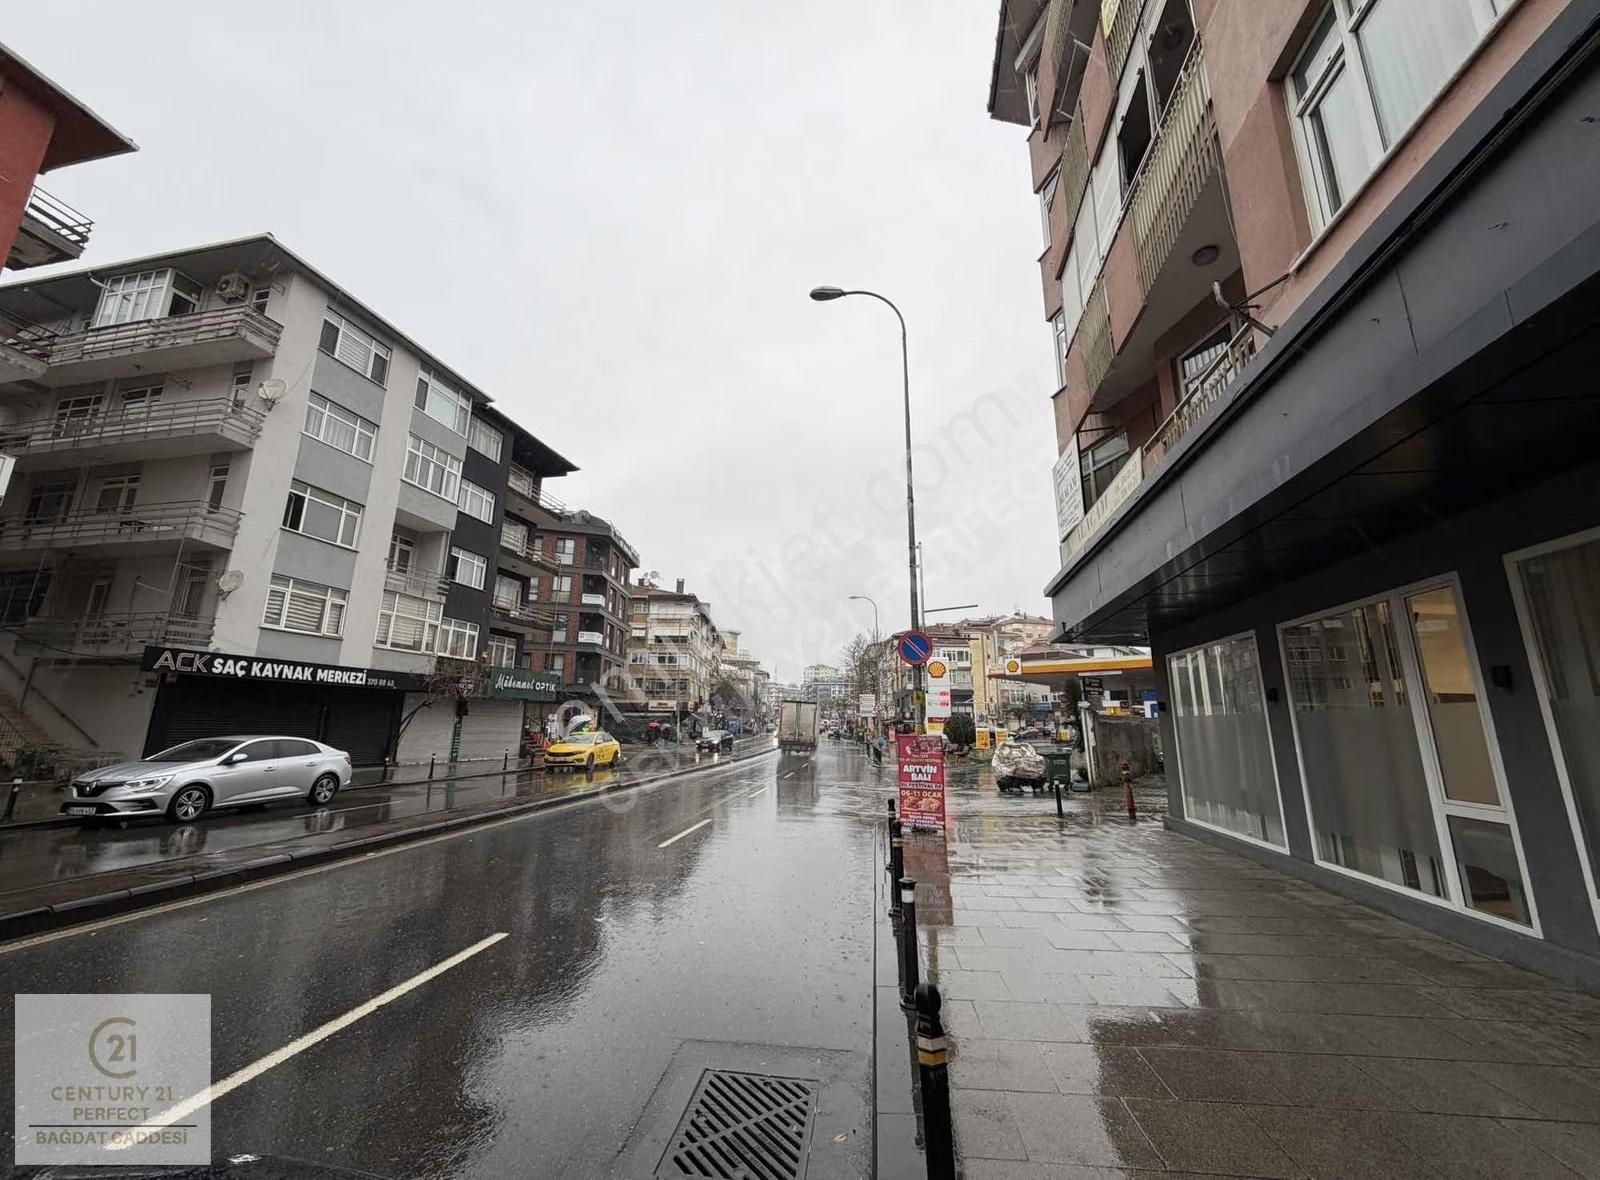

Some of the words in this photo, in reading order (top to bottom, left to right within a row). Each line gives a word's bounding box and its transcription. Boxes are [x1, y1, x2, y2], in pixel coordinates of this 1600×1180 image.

[153, 650, 211, 673] ACK
[211, 658, 248, 677] SAÇ
[251, 662, 314, 681] KAYNAK
[316, 669, 367, 685] MERKEZİ
[903, 763, 938, 774] ARTVİN
[922, 790, 943, 798] OCAK
